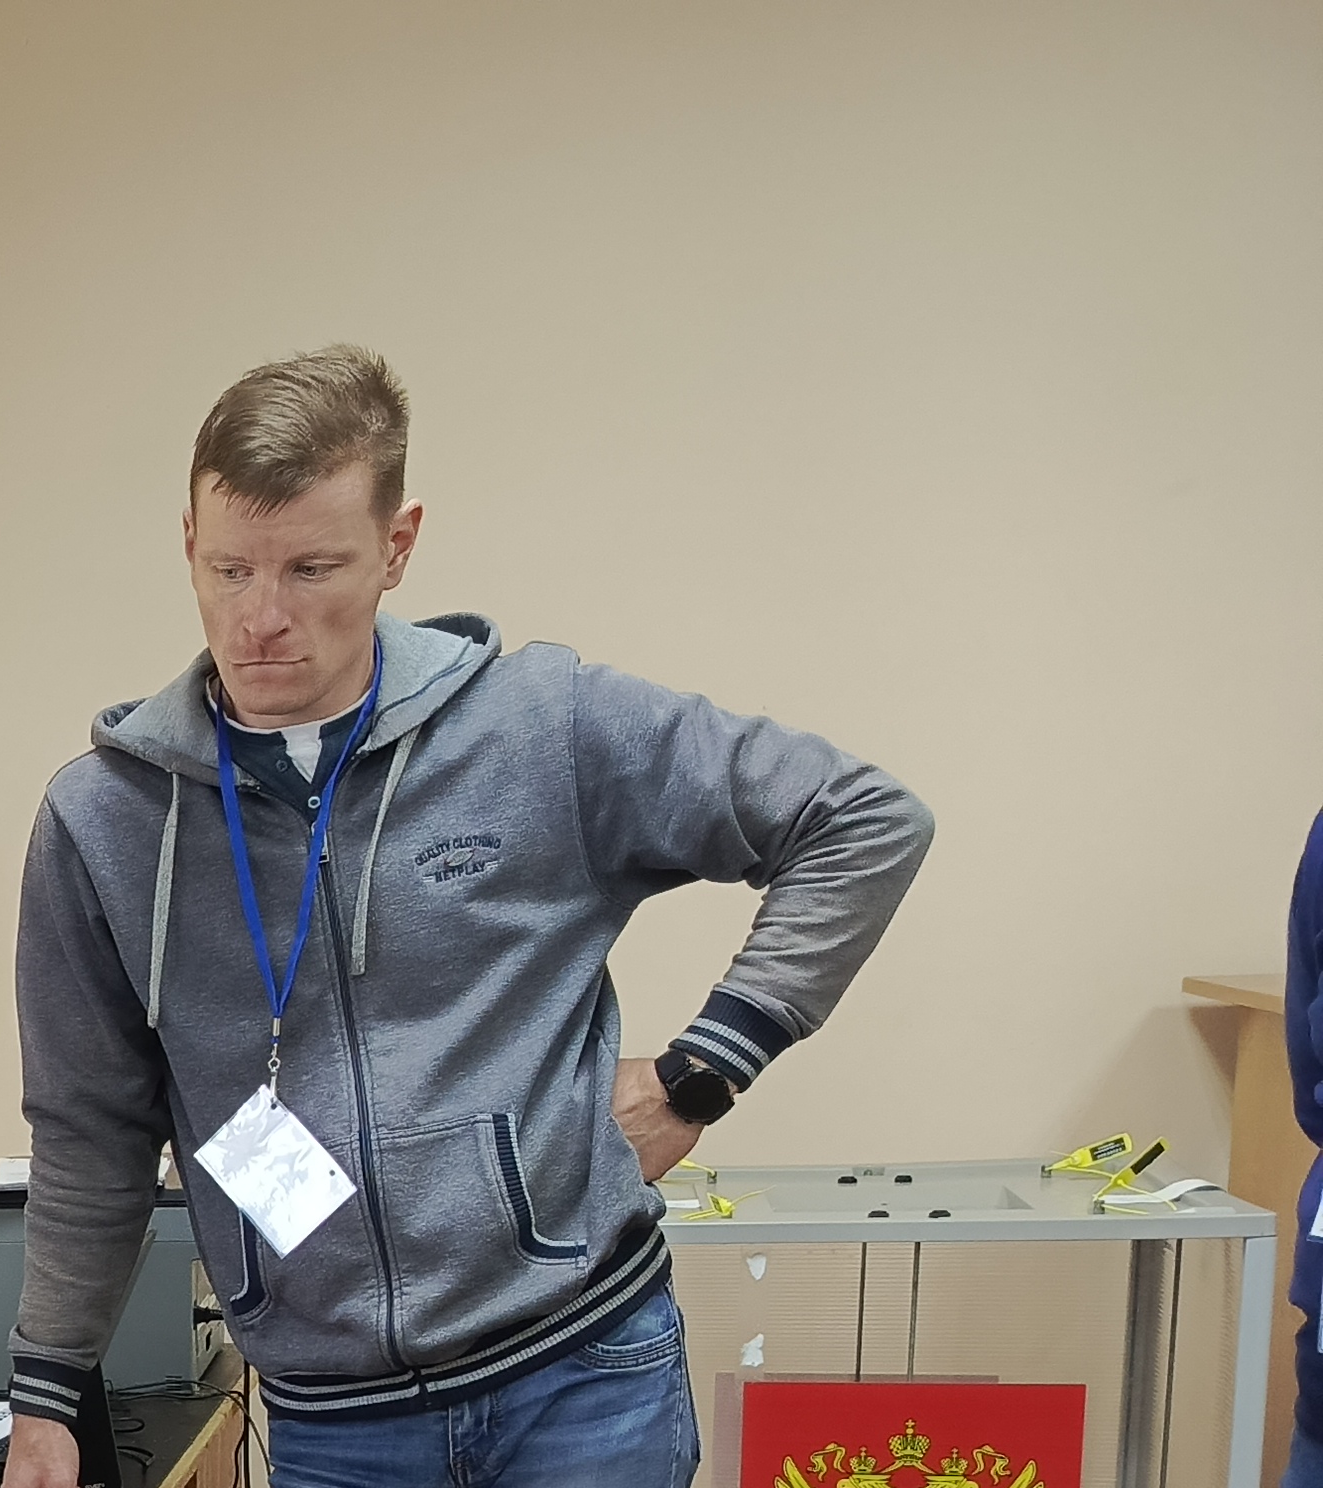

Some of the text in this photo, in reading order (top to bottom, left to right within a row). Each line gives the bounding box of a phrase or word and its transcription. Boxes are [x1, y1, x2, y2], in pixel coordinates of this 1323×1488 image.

[414, 834, 502, 867] QUALITY CLOTHING
[434, 861, 487, 883] NETPLAY
